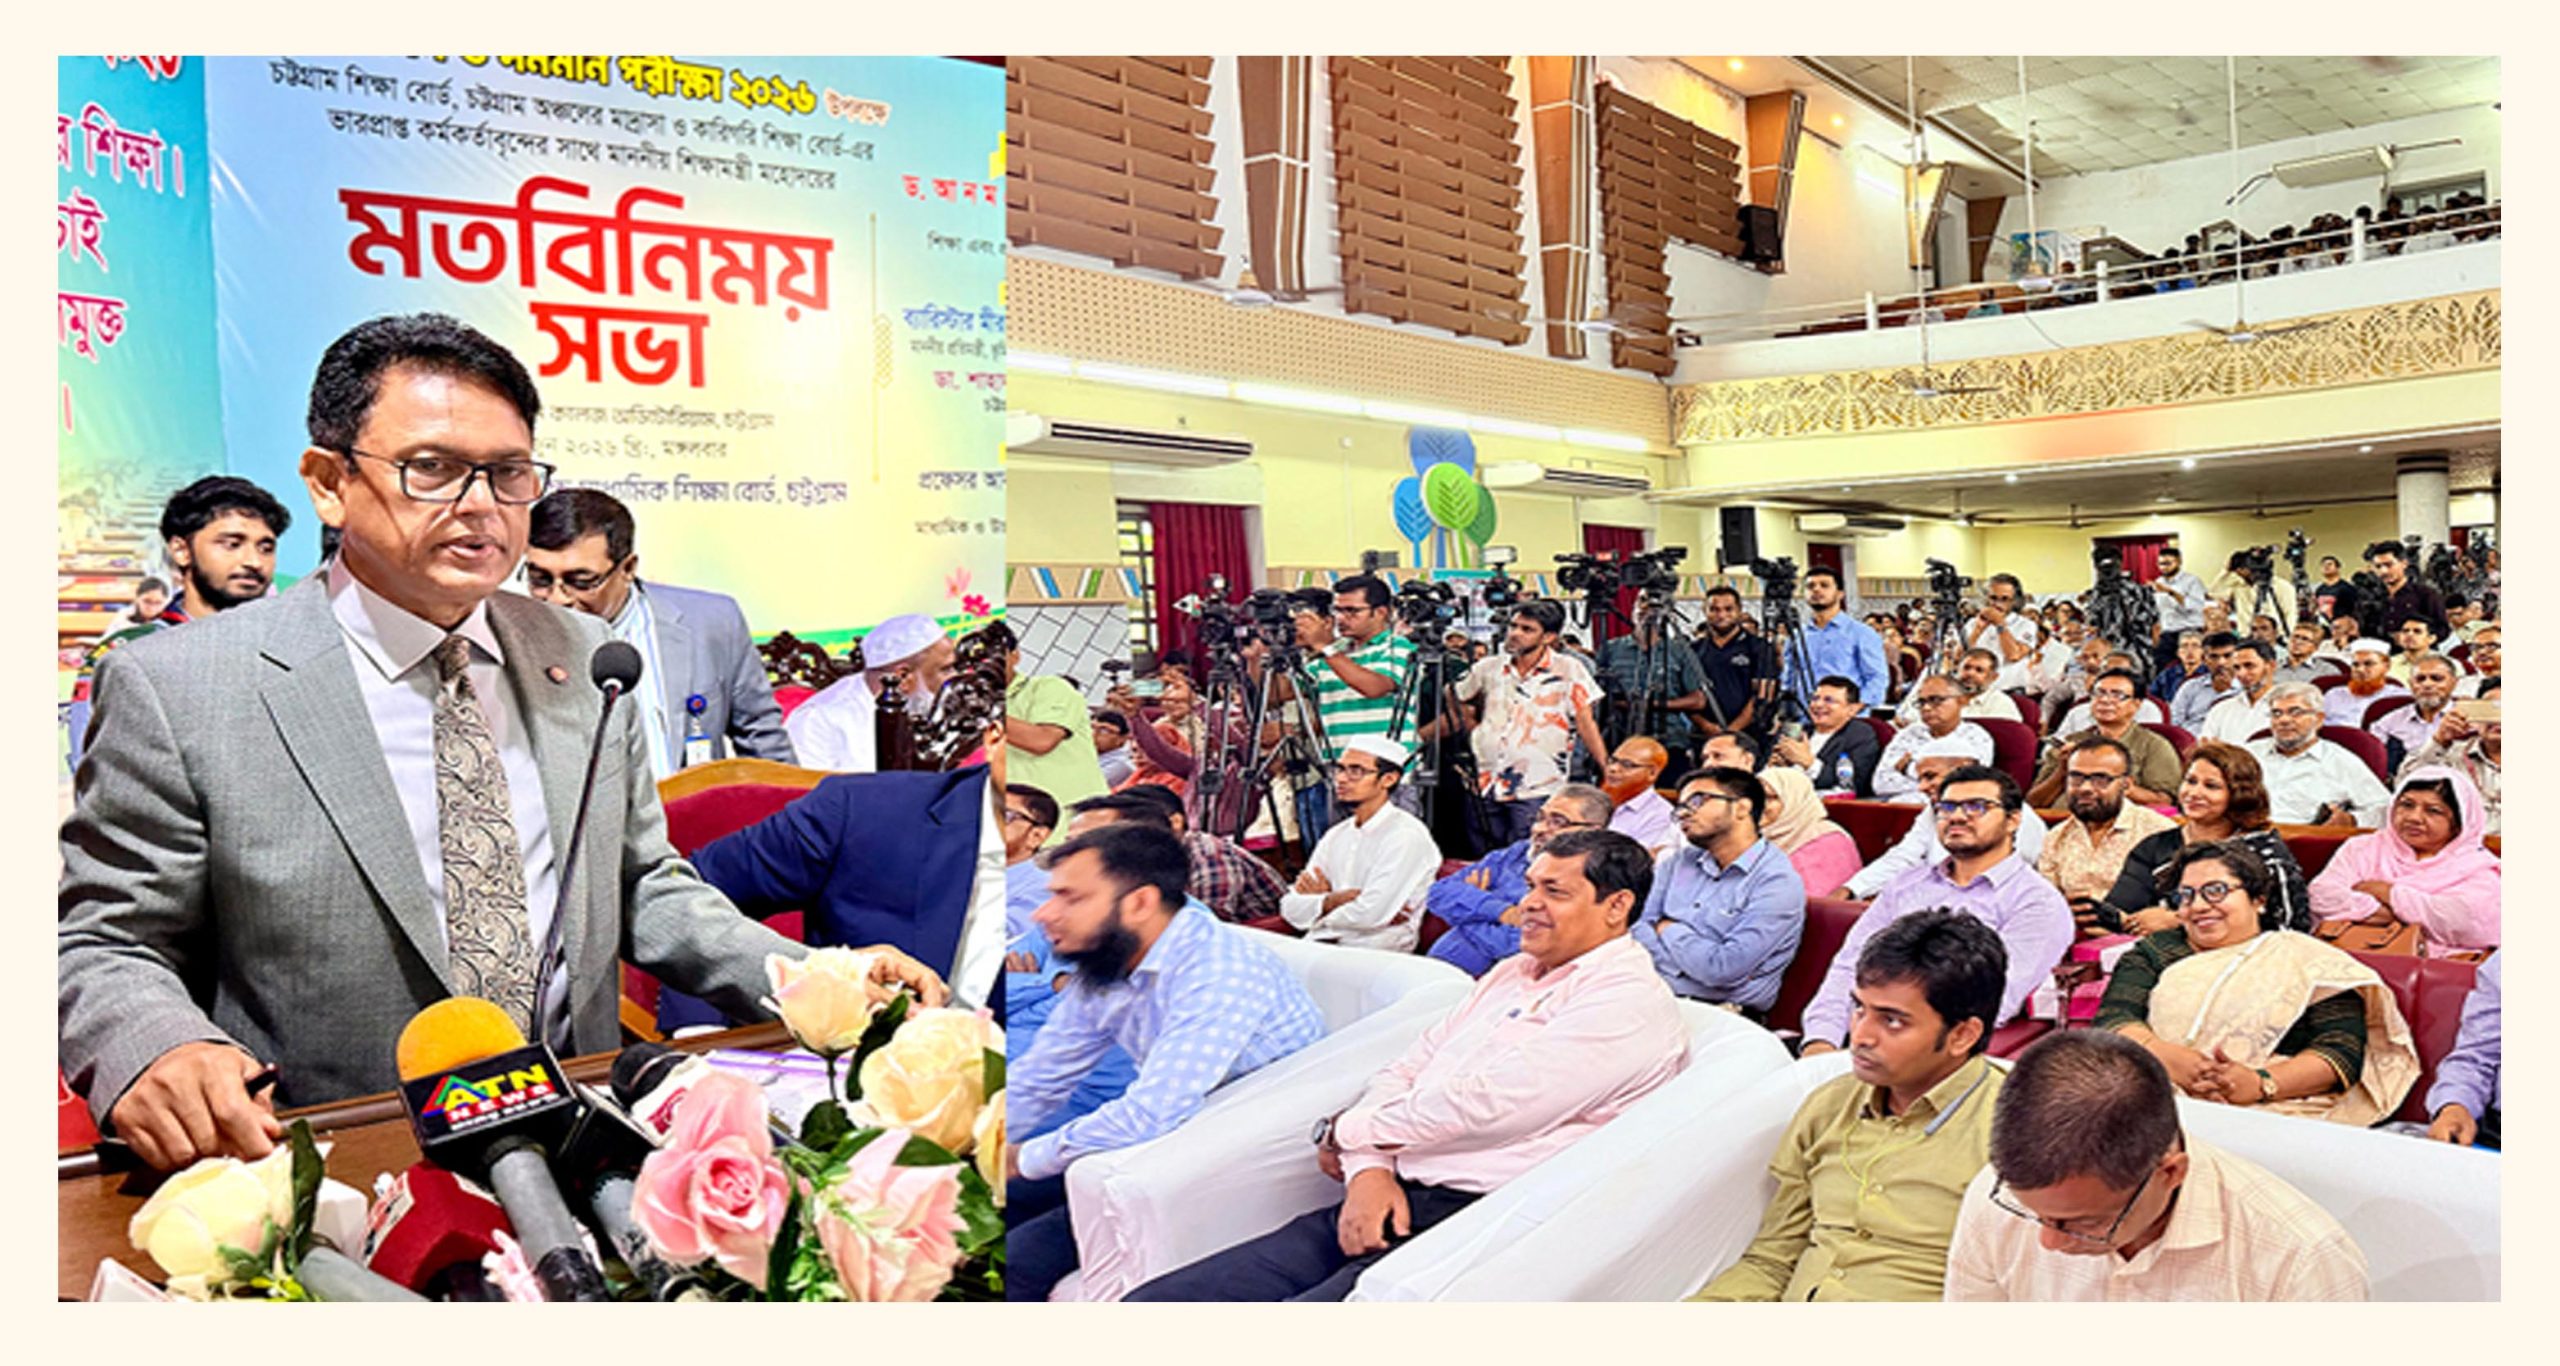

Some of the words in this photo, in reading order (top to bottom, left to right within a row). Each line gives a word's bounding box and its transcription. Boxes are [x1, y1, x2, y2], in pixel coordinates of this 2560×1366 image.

[269, 58, 338, 92] চট্টগ্রাম
[345, 64, 397, 100] শিক্ষা
[406, 78, 458, 110] বোর্ড,
[465, 84, 527, 115] চট্টগ্রাম
[532, 97, 603, 124] অঞ্চলের
[609, 106, 665, 134] মাদ্রাসা
[673, 118, 687, 137] ও
[693, 115, 757, 147] কারিগরি
[762, 122, 802, 153] শিক্ষা
[617, 56, 724, 102] পরীক্ষা
[729, 69, 817, 115] ২০২৬
[327, 107, 410, 139] ভারপ্রাপ্ত
[417, 116, 549, 160] কর্মকর্তাবৃন্দের
[557, 136, 600, 161] সাথে
[607, 140, 671, 171] মাননীয়
[676, 146, 751, 181] শিক্ষামন্ত্রী
[758, 162, 836, 190] মহোদয়ের
[338, 176, 833, 322] মতবিনিময়
[927, 229, 962, 253] শিক্ষা
[530, 302, 709, 388] সভা
[902, 302, 974, 330] ব্যারিস্টার
[674, 473, 730, 502] শিক্ষা
[786, 477, 847, 507] চট্টগ্রাম
[444, 1063, 549, 1112] ATN
